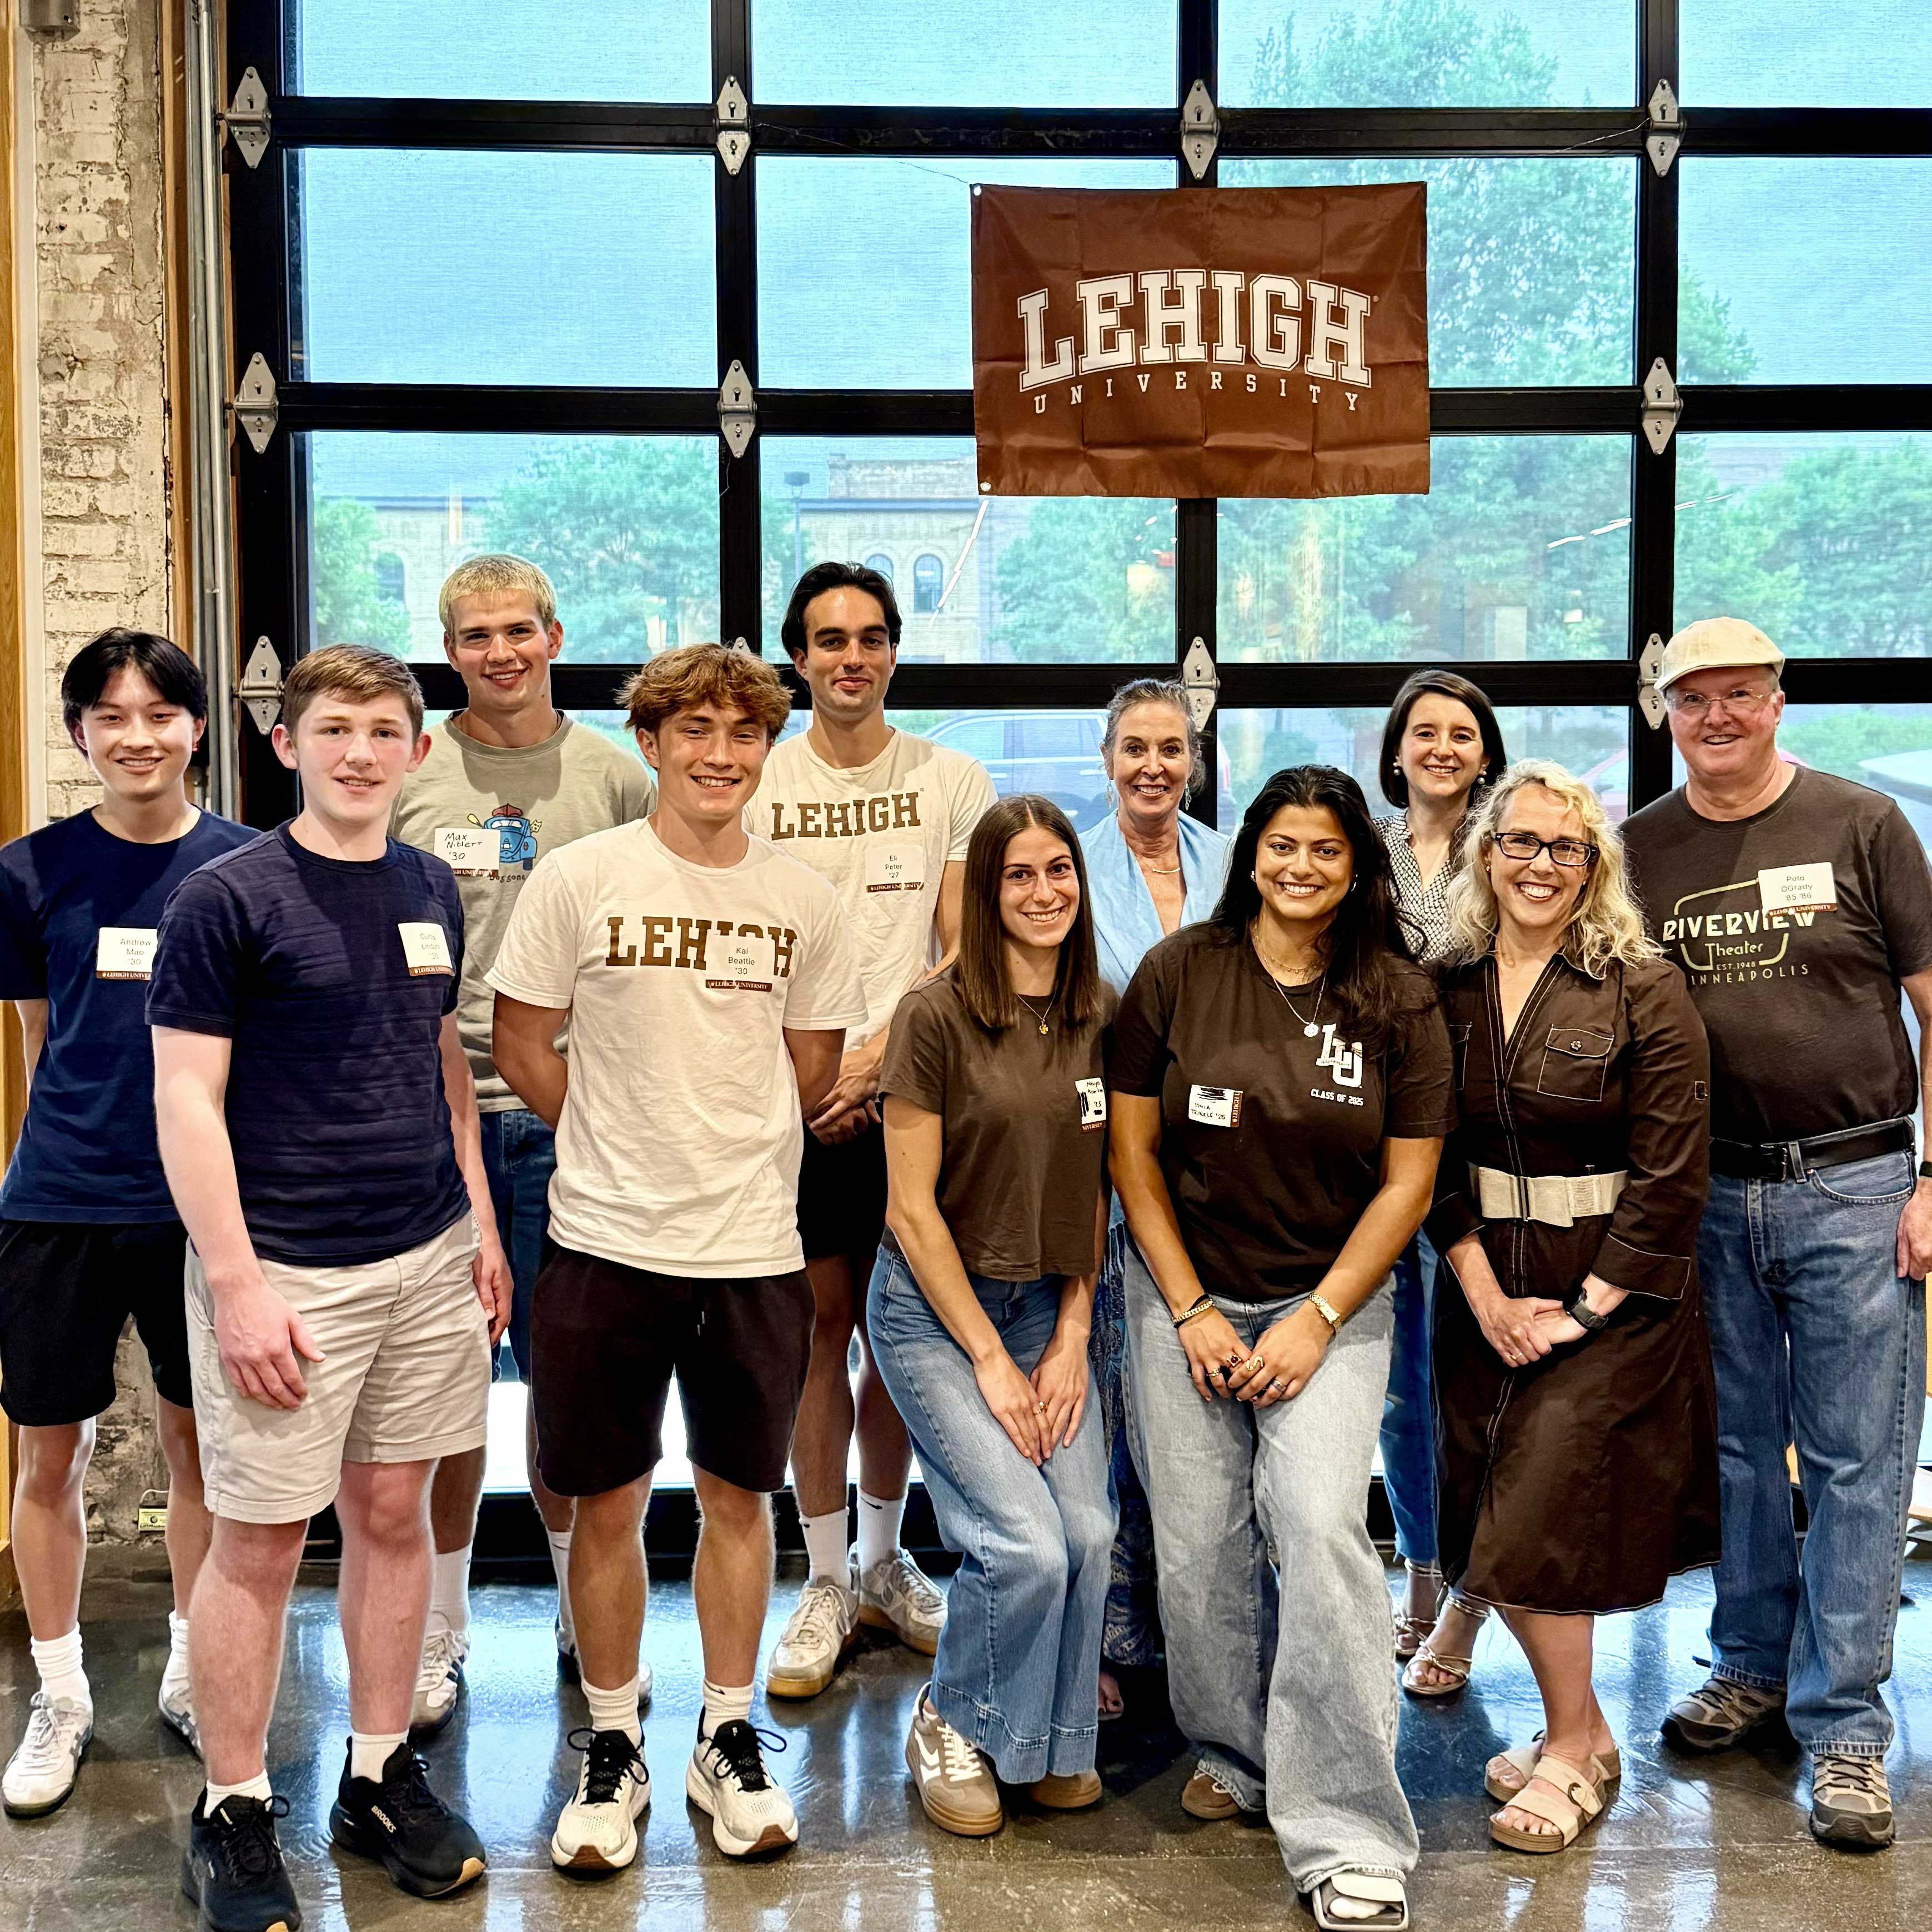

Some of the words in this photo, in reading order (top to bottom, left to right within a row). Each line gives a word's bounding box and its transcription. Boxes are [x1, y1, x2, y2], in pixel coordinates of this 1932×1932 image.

[1017, 269, 1372, 392] LEHIGH
[1034, 372, 1359, 414] UNIVERSITY
[771, 792, 921, 841] LEHIGH
[444, 832, 468, 841] Max
[449, 852, 465, 861] '30
[1663, 909, 1815, 941] RIVERVIEW
[606, 916, 797, 978] LEHH
[728, 956, 755, 965] Beattie
[1704, 940, 1764, 960] Theater
[1691, 964, 1808, 985] INNEAPOLIS
[1316, 1023, 1363, 1088] LU
[1311, 1088, 1335, 1101] CLASS
[1337, 1093, 1347, 1103] OF
[1348, 1096, 1364, 1106] 2025
[372, 1805, 397, 1833] BROOKS
